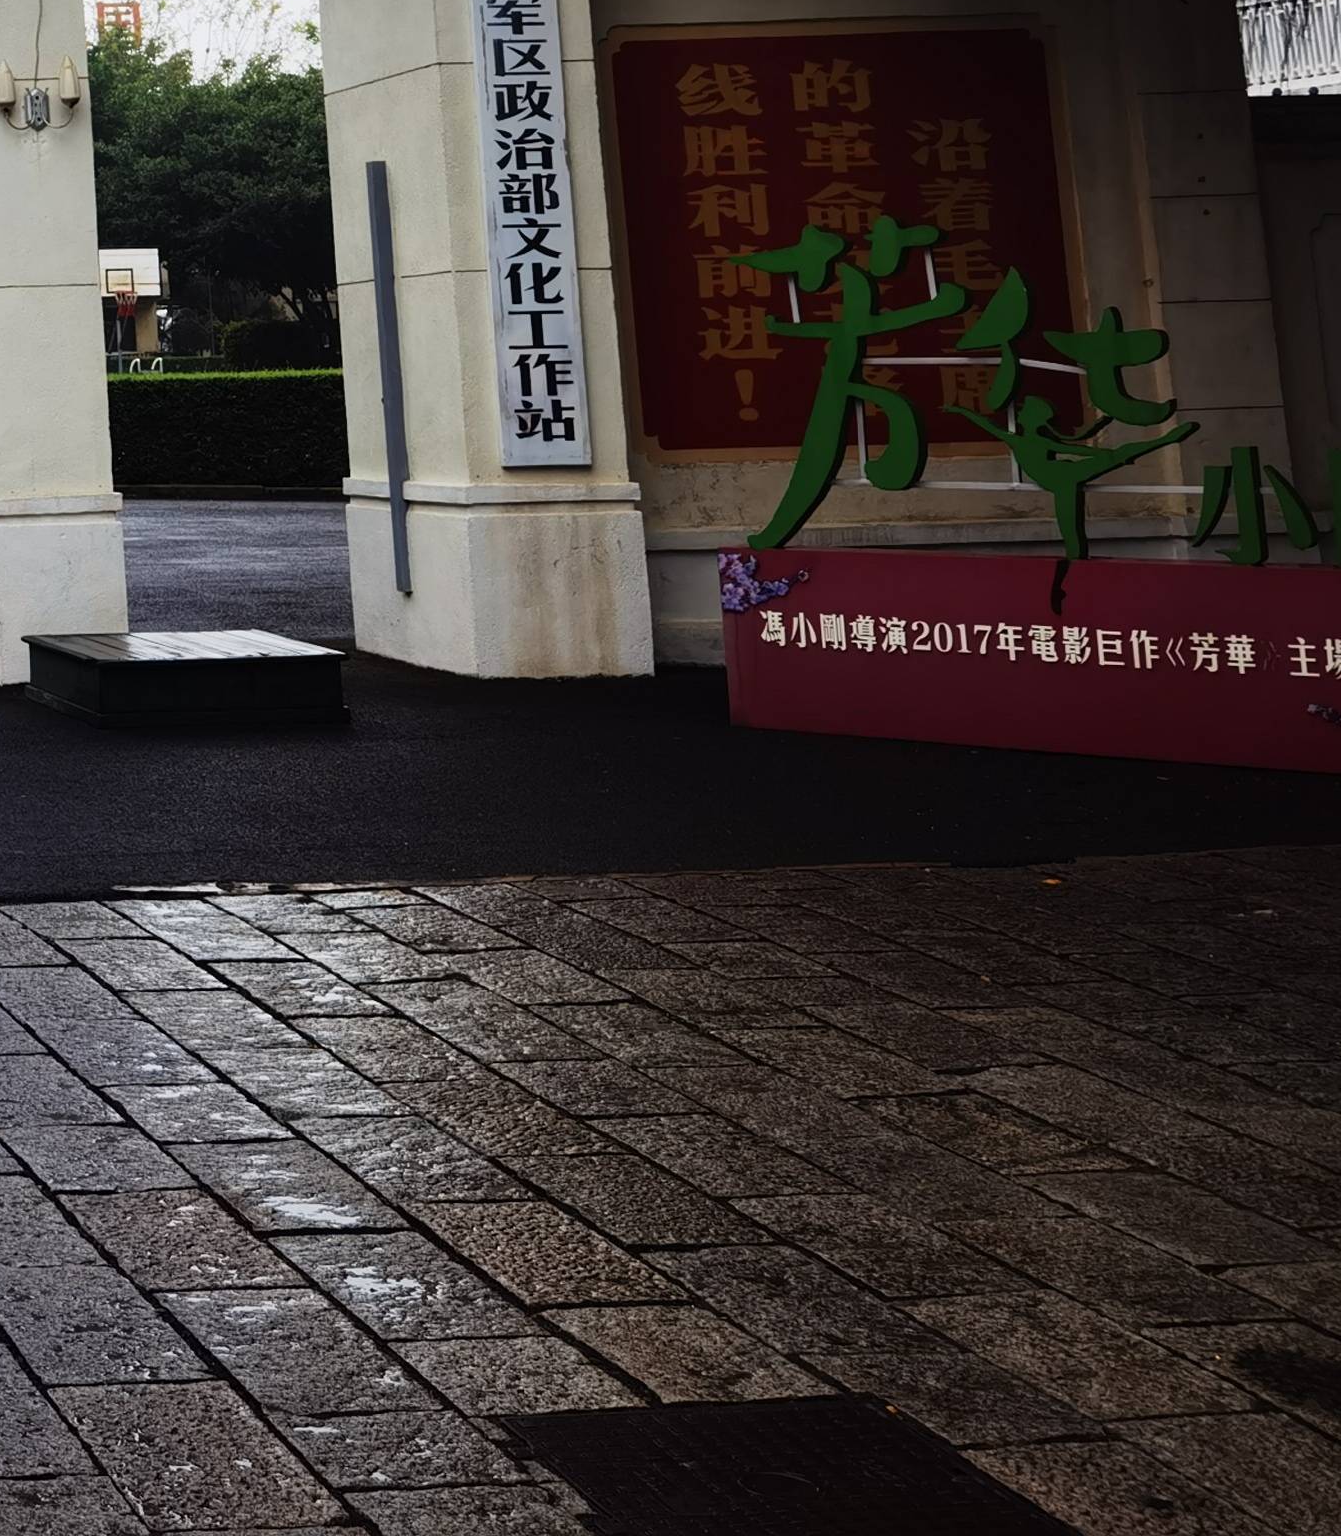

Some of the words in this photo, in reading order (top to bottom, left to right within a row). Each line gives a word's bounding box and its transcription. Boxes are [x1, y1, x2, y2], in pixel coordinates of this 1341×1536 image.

[675, 62, 783, 421] 线胜利前进!
